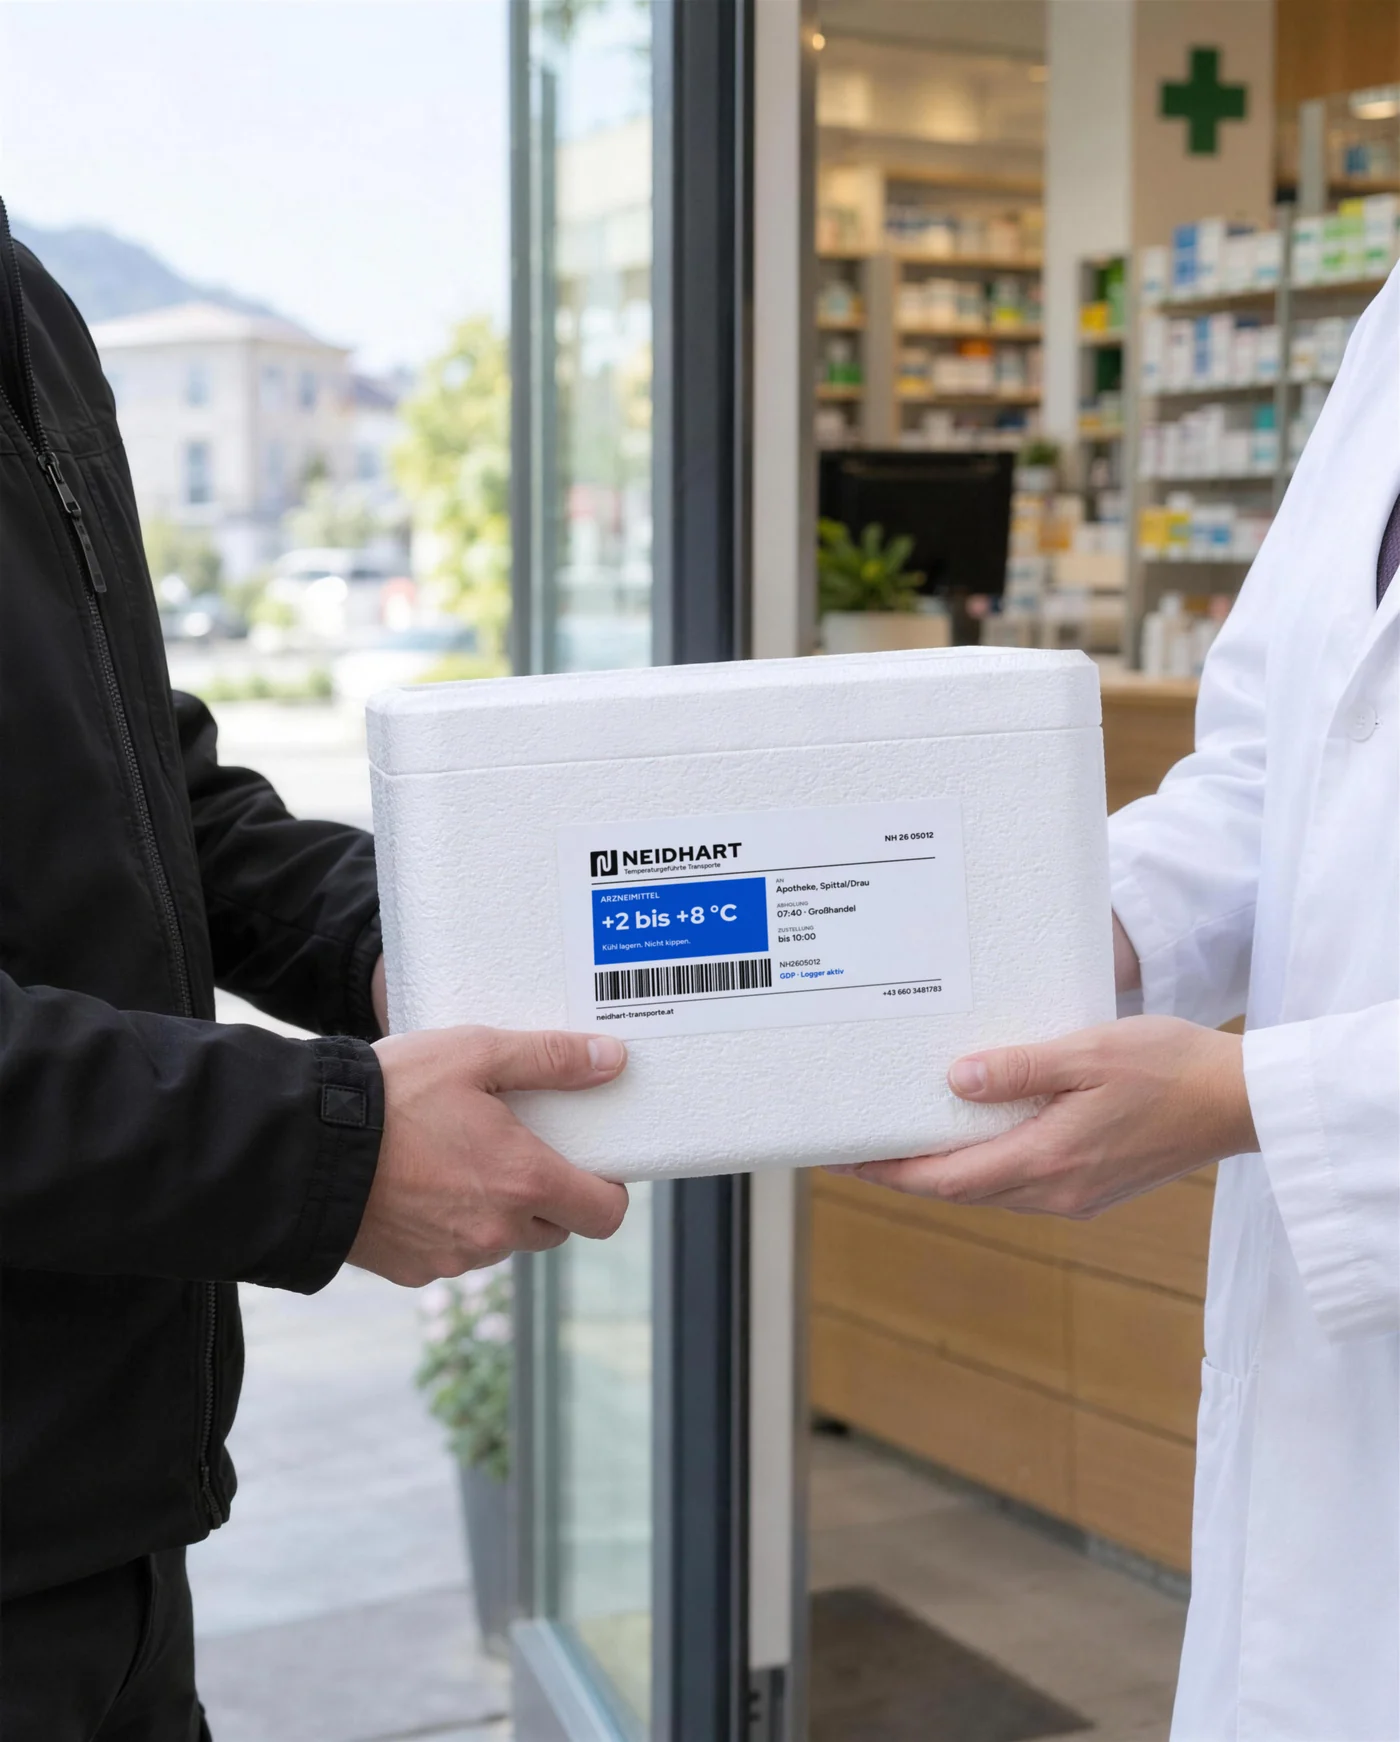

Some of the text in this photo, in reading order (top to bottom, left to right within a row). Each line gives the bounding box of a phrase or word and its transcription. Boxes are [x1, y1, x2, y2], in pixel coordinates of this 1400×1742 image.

[884, 831, 934, 842] NH 26 05012
[623, 842, 742, 866] NEIDHART
[624, 862, 721, 875] Temperaturgeführte Transporte
[776, 879, 870, 894] Apotheke, Spittal/Drau
[600, 892, 660, 903] ARZNEIMITTEL
[602, 903, 737, 931] +2 bis +8 °C
[777, 909, 802, 918] 07:40
[808, 905, 856, 916] Großhandel
[778, 925, 814, 933] ZUSTELLUNG
[778, 933, 816, 943] bis 10:00
[602, 938, 691, 951] Kühl lagern. Nicht kippen.
[779, 959, 821, 968] NH2605012
[780, 972, 796, 980] GDP
[801, 970, 825, 979] Logger
[827, 968, 844, 976] aktiv
[913, 985, 942, 994] 3481783
[596, 1008, 674, 1021] neidhart-transporte.at
